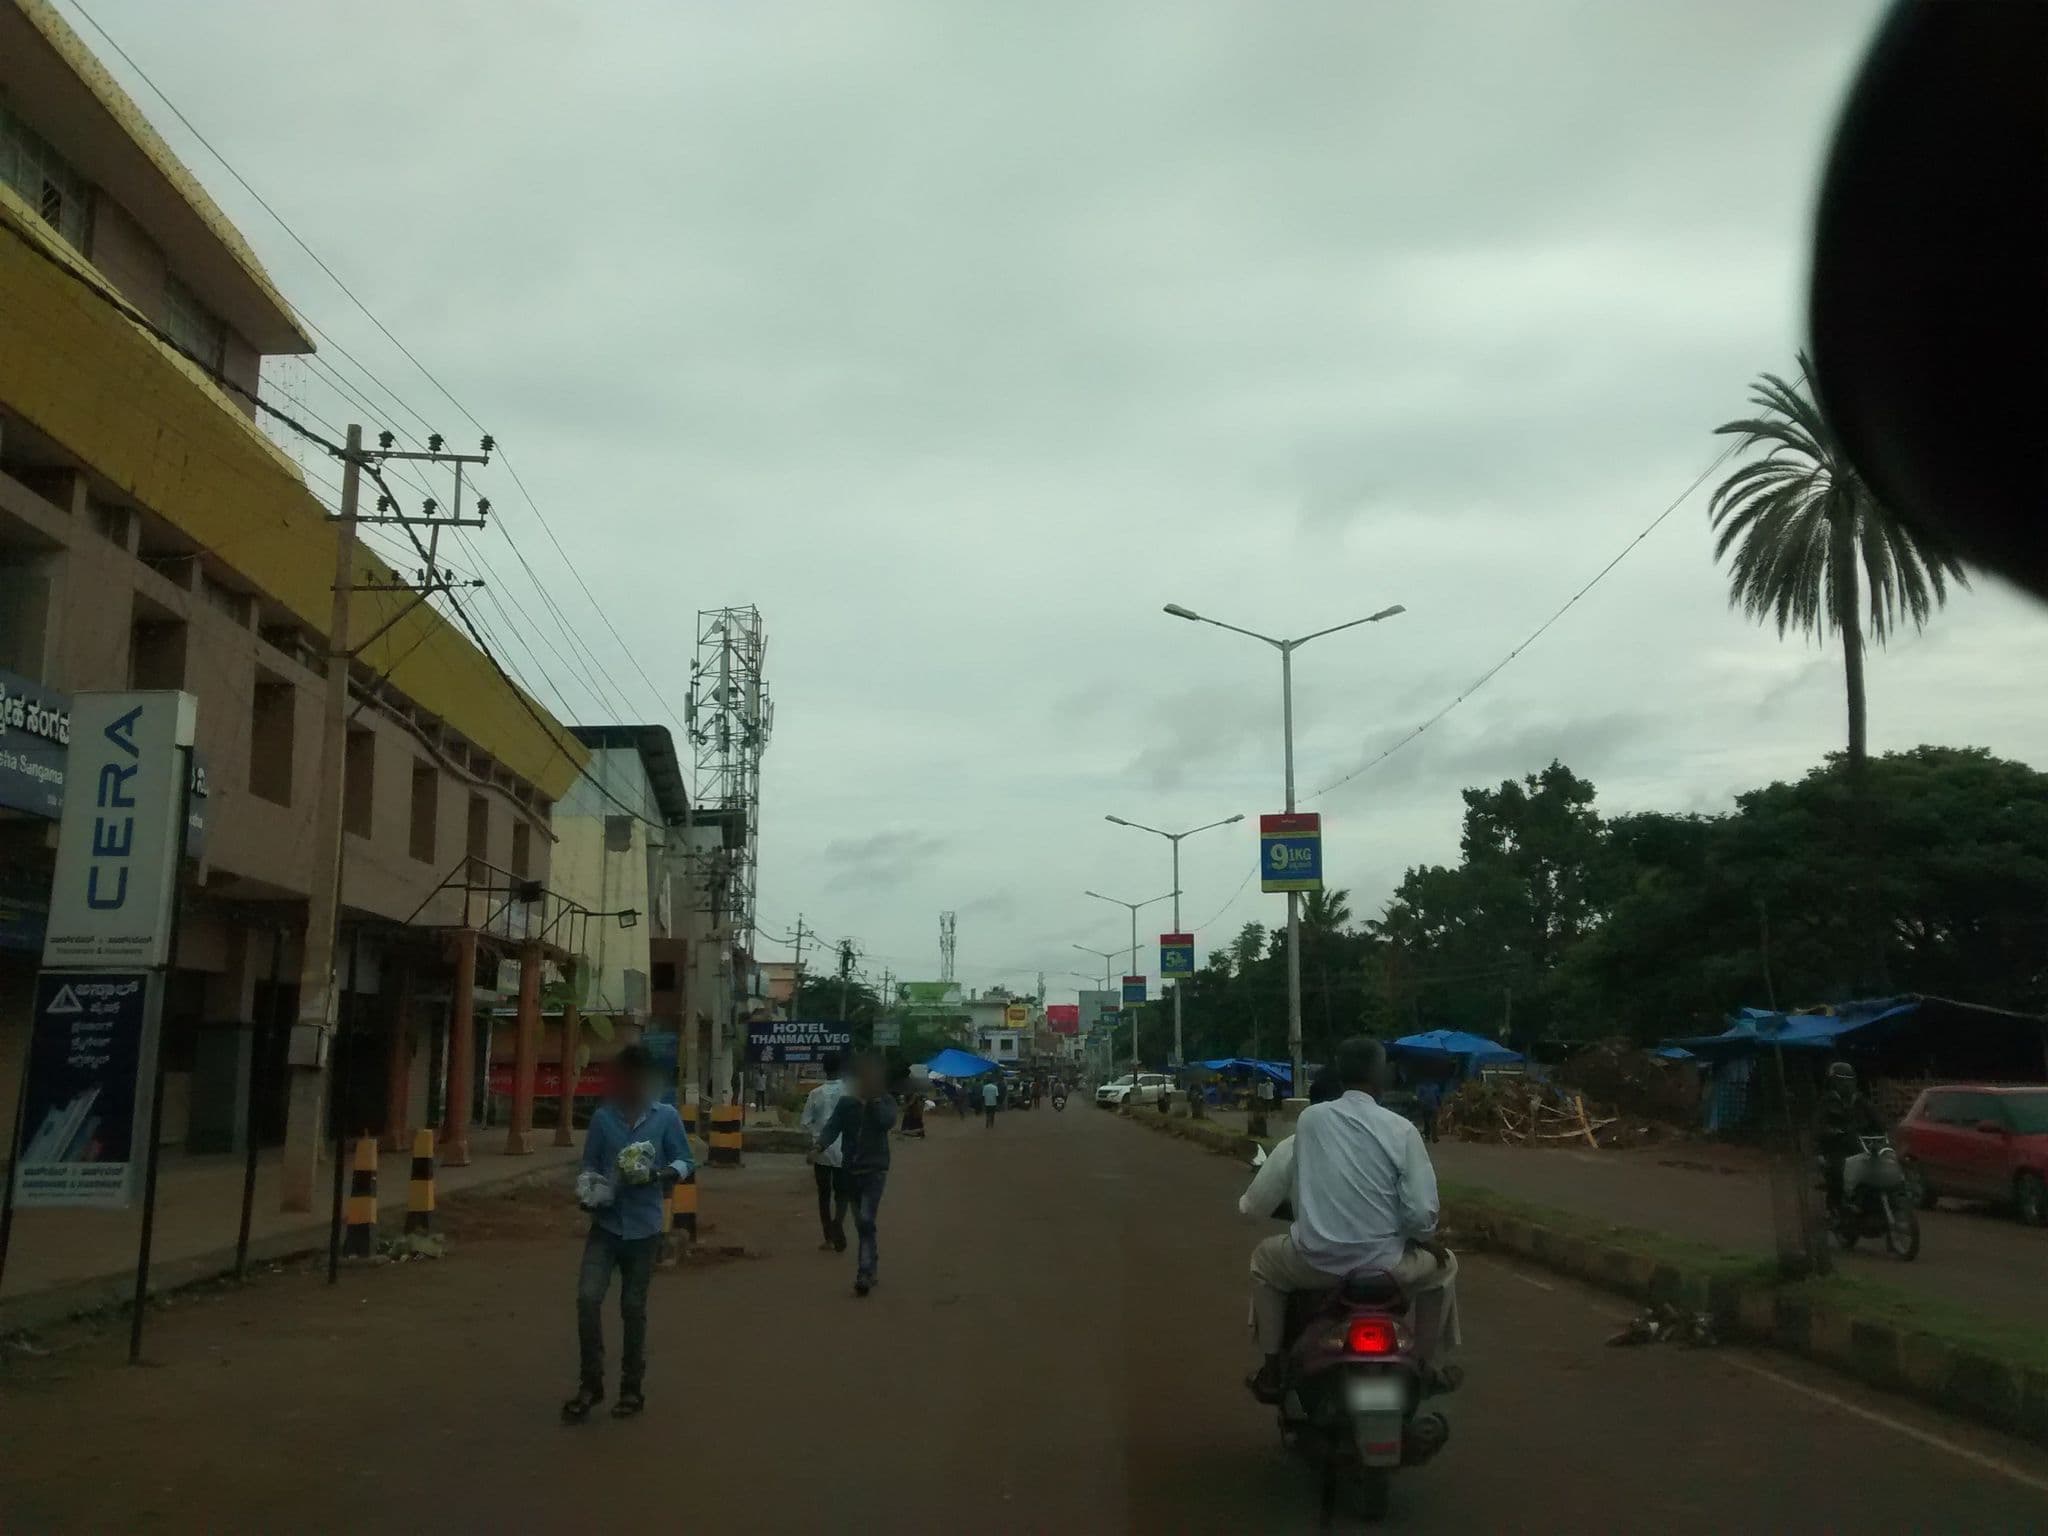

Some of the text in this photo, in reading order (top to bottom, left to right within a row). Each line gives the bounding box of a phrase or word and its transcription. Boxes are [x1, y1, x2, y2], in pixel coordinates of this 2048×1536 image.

[20, 754, 63, 783] Sangama
[87, 705, 143, 910] CERA
[773, 1023, 828, 1033] HOTEL
[750, 1033, 850, 1044] THANMAYA VEG
